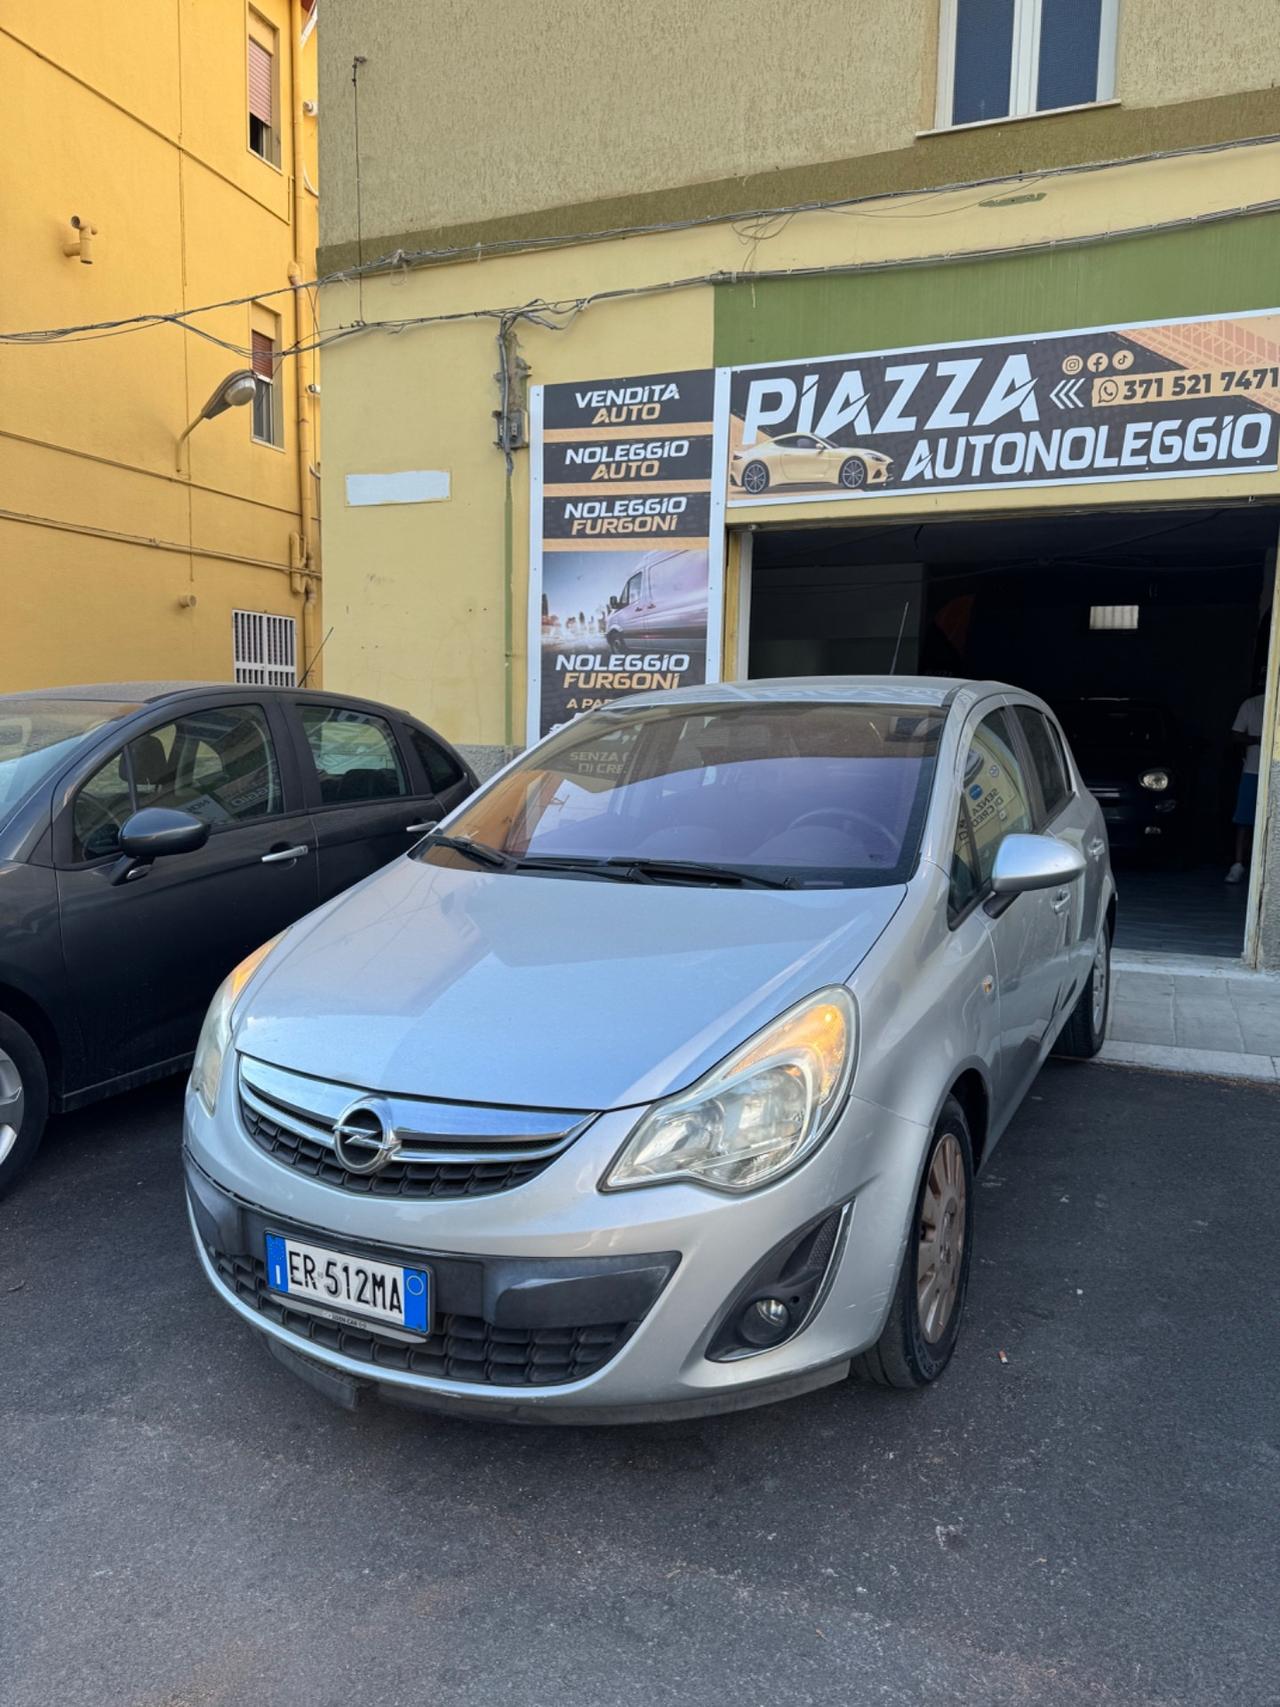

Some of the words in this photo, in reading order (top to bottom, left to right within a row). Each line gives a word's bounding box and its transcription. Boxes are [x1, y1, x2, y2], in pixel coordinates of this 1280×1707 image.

[742, 353, 1039, 446] PIAZZA
[1122, 377, 1164, 401] 371
[1171, 373, 1212, 396] 521
[1220, 366, 1279, 392] 7471
[592, 403, 661, 425] AUTO
[901, 412, 1273, 481] AUTONOLEGGIO
[591, 460, 660, 481] AUTO
[566, 698, 578, 709] A
[289, 1250, 317, 1290] ER
[324, 1260, 402, 1313] 512MA
